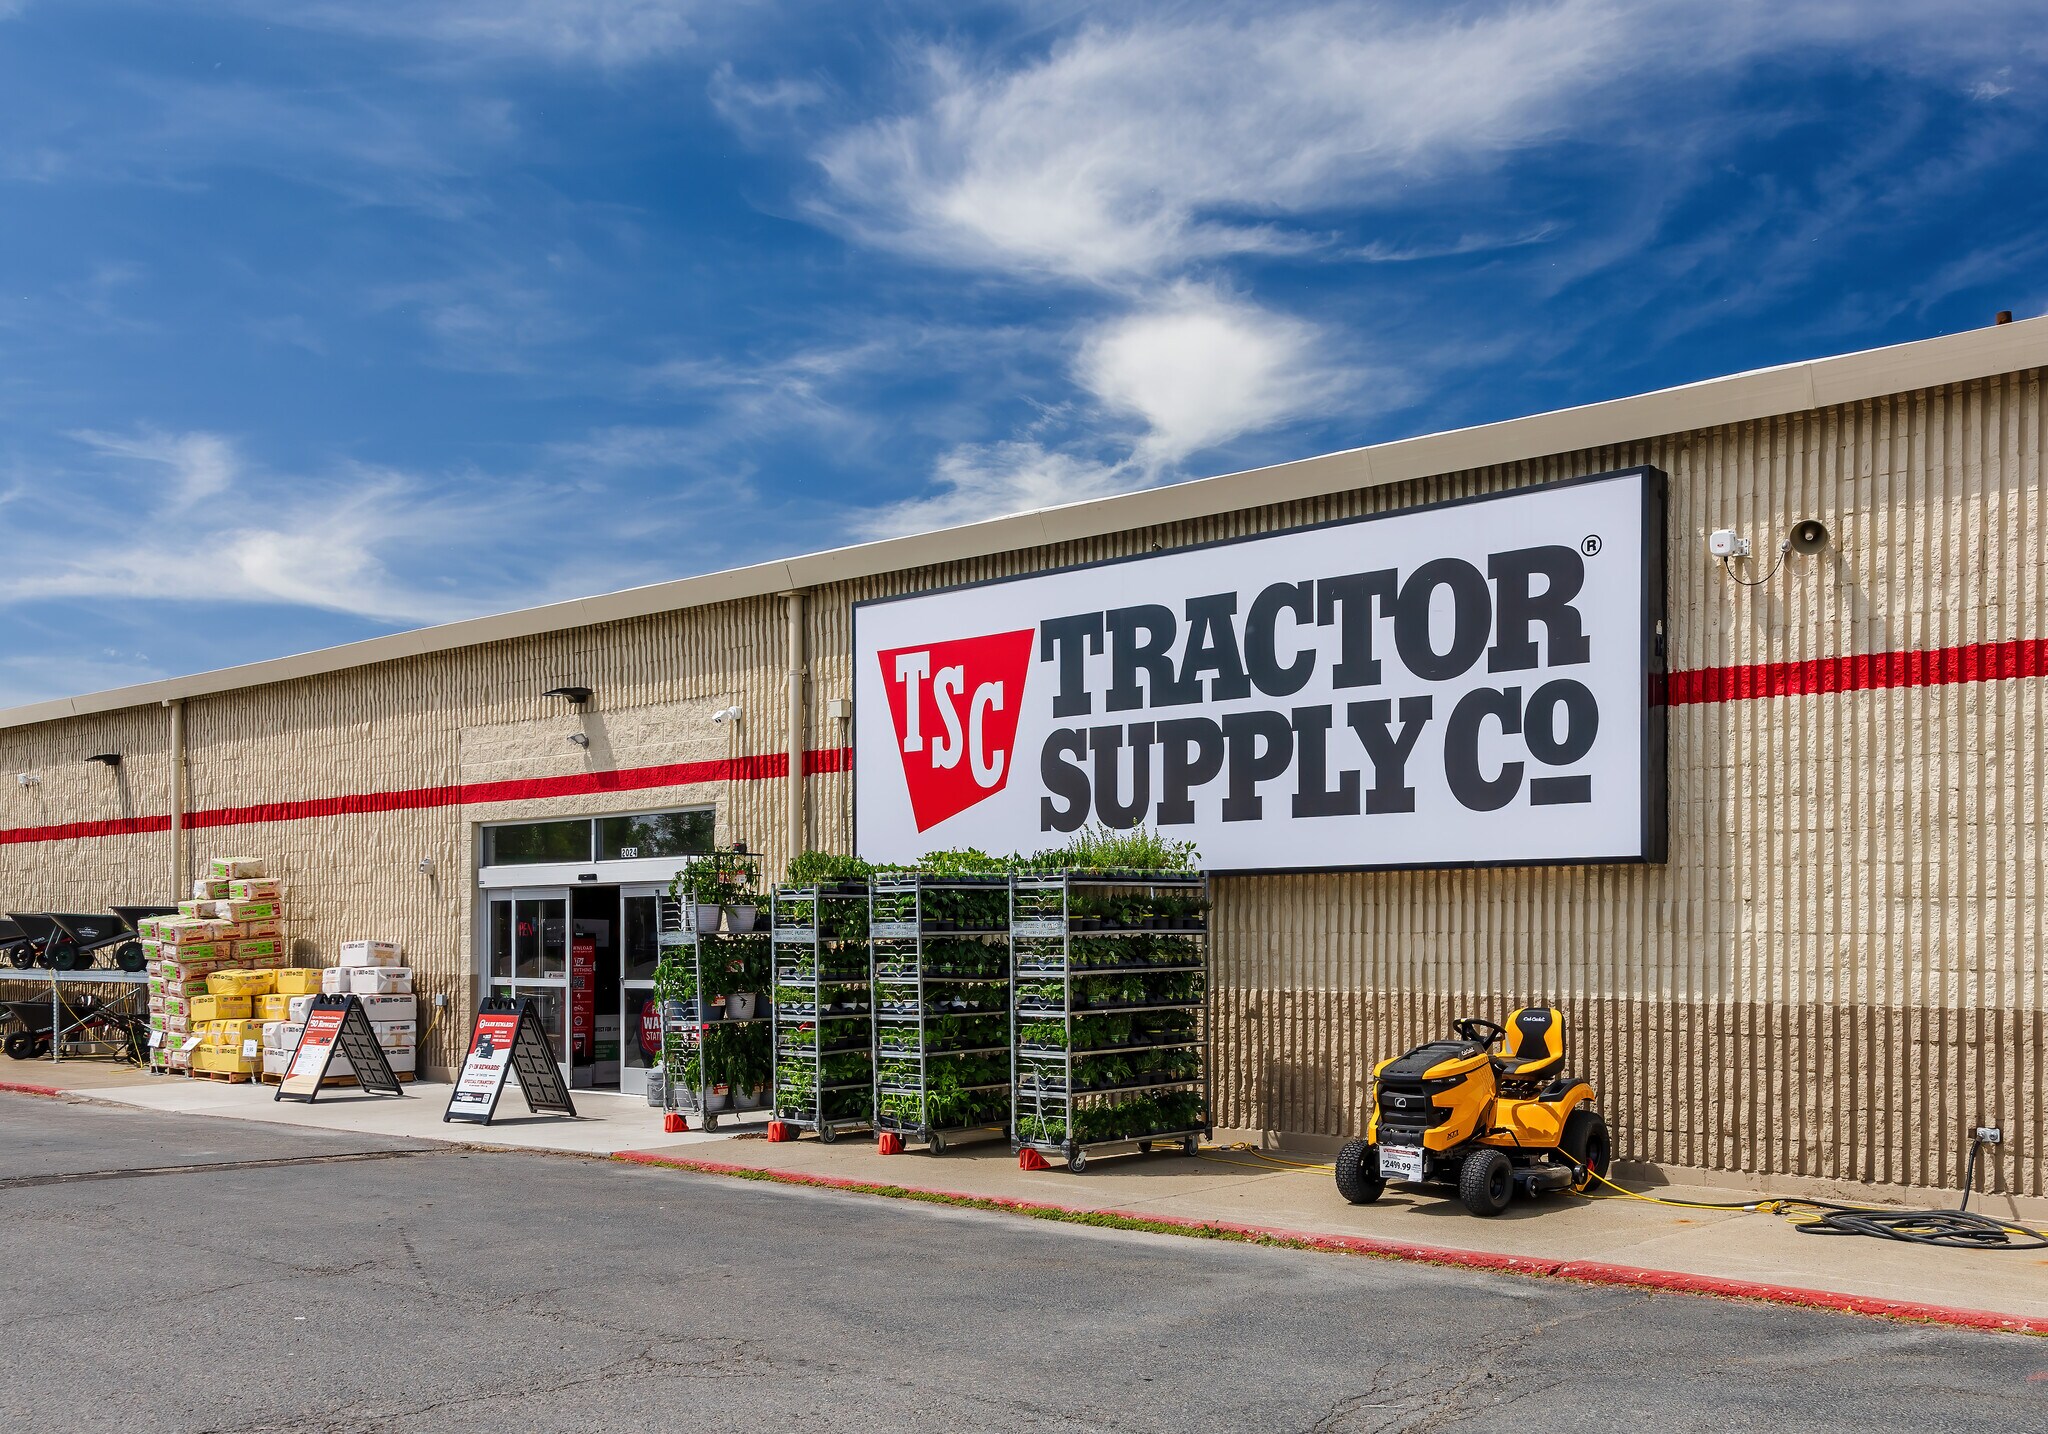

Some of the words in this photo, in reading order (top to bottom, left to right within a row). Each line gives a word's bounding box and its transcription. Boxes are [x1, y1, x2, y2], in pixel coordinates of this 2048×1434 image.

[1041, 545, 1590, 718] TRACTOR
[895, 651, 1005, 788] TSC
[1041, 695, 1433, 833] SUPPLY
[621, 848, 637, 857] 2024
[518, 921, 533, 937] PEN
[643, 1016, 661, 1030] WA
